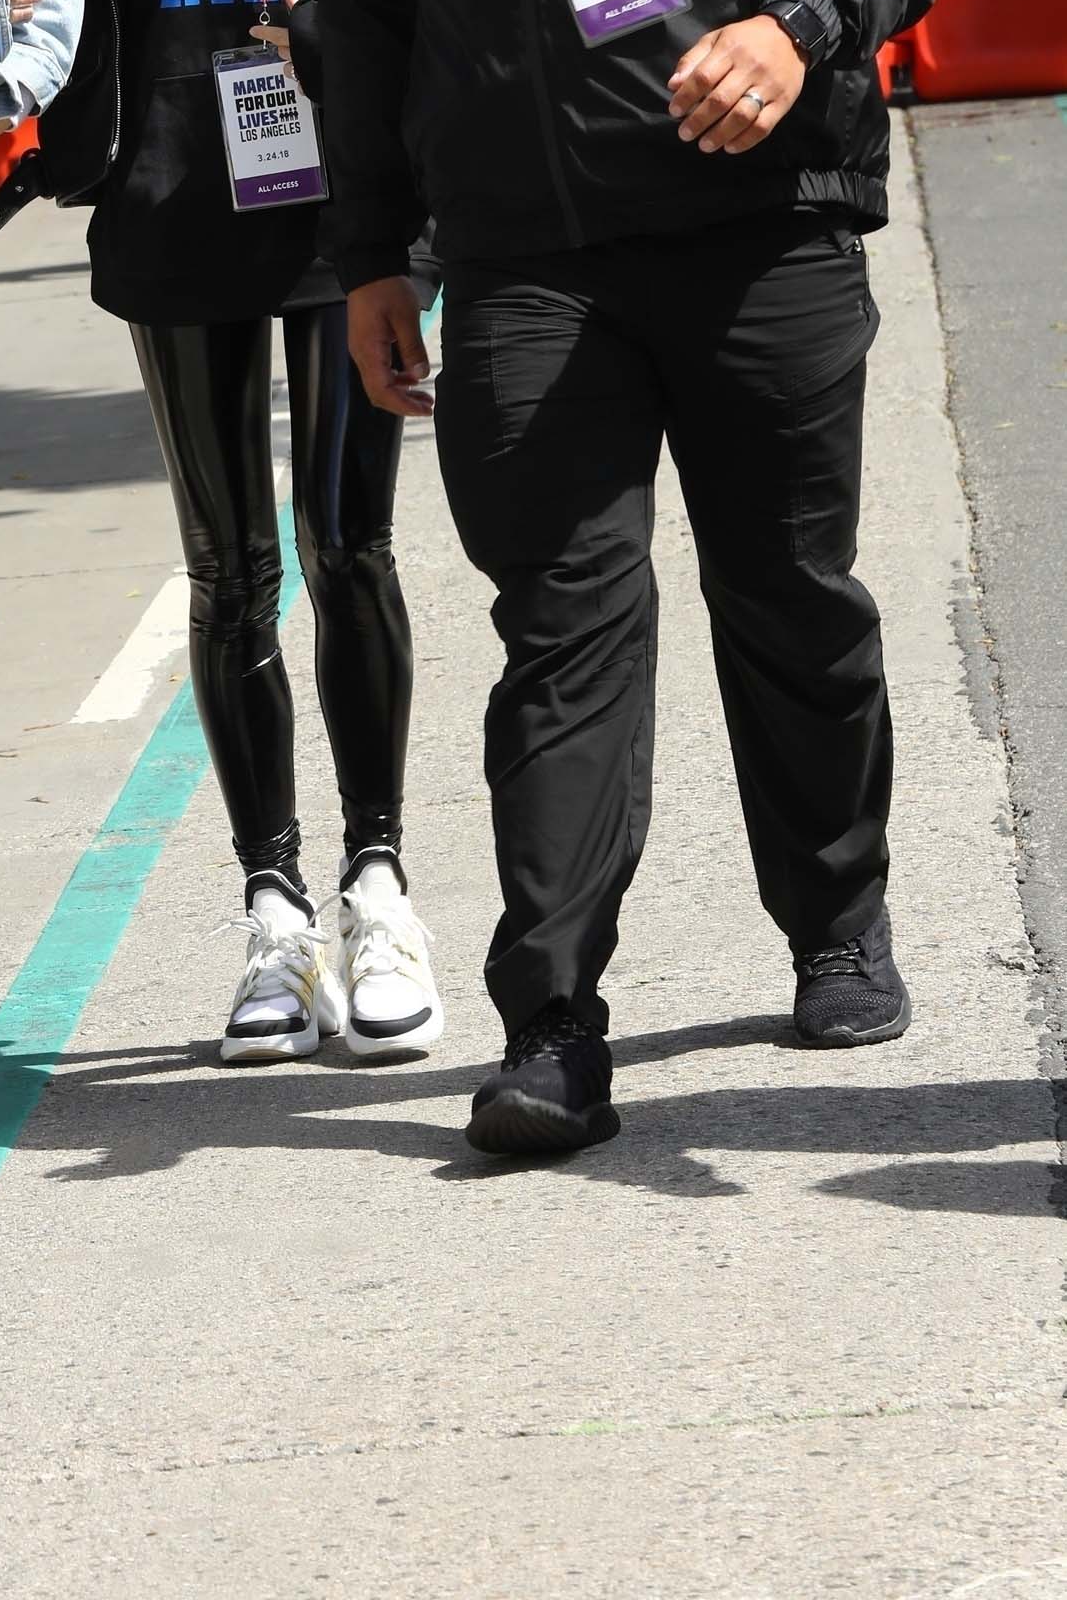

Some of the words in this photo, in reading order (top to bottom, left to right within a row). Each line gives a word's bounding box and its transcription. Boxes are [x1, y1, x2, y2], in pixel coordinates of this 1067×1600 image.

[605, 9, 622, 19] ALL
[233, 74, 286, 97] MARCH
[235, 95, 267, 113] FOR
[267, 89, 297, 111] OUR
[238, 109, 279, 130] LIVES
[240, 129, 258, 143] LOS
[260, 121, 302, 139] ANGELES
[258, 150, 290, 162] 3.24.18
[258, 185, 271, 193] ALL
[272, 180, 300, 191] ACCESS
